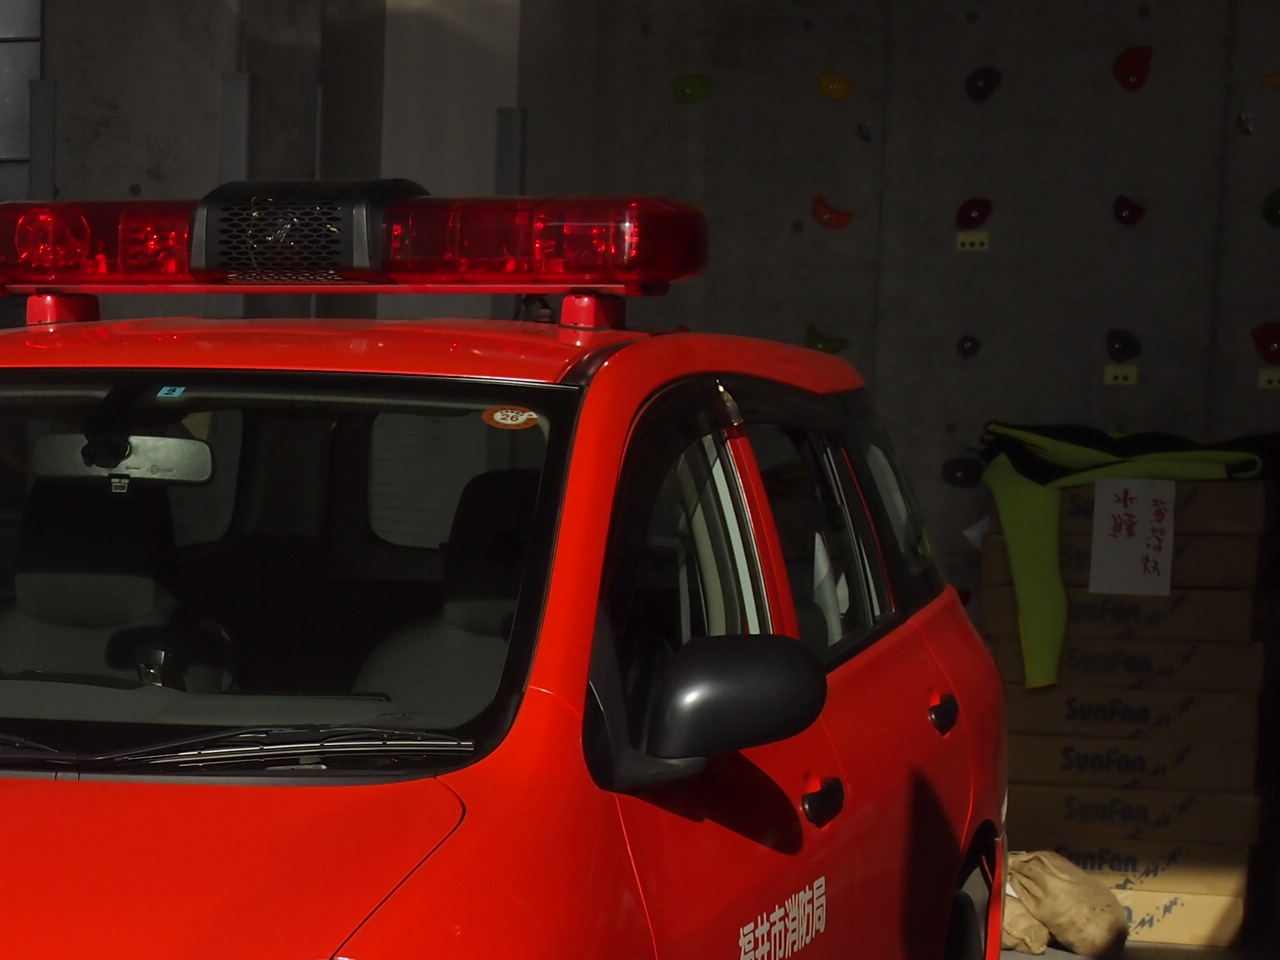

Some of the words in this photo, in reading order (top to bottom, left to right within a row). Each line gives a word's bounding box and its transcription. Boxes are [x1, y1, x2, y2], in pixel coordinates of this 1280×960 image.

[500, 414, 519, 422] 26
[1069, 598, 1141, 622] unFan
[1067, 648, 1152, 673] SunFan
[1065, 697, 1150, 723] SunFan
[1060, 746, 1146, 773] SunFan
[1063, 796, 1149, 823] SunFan
